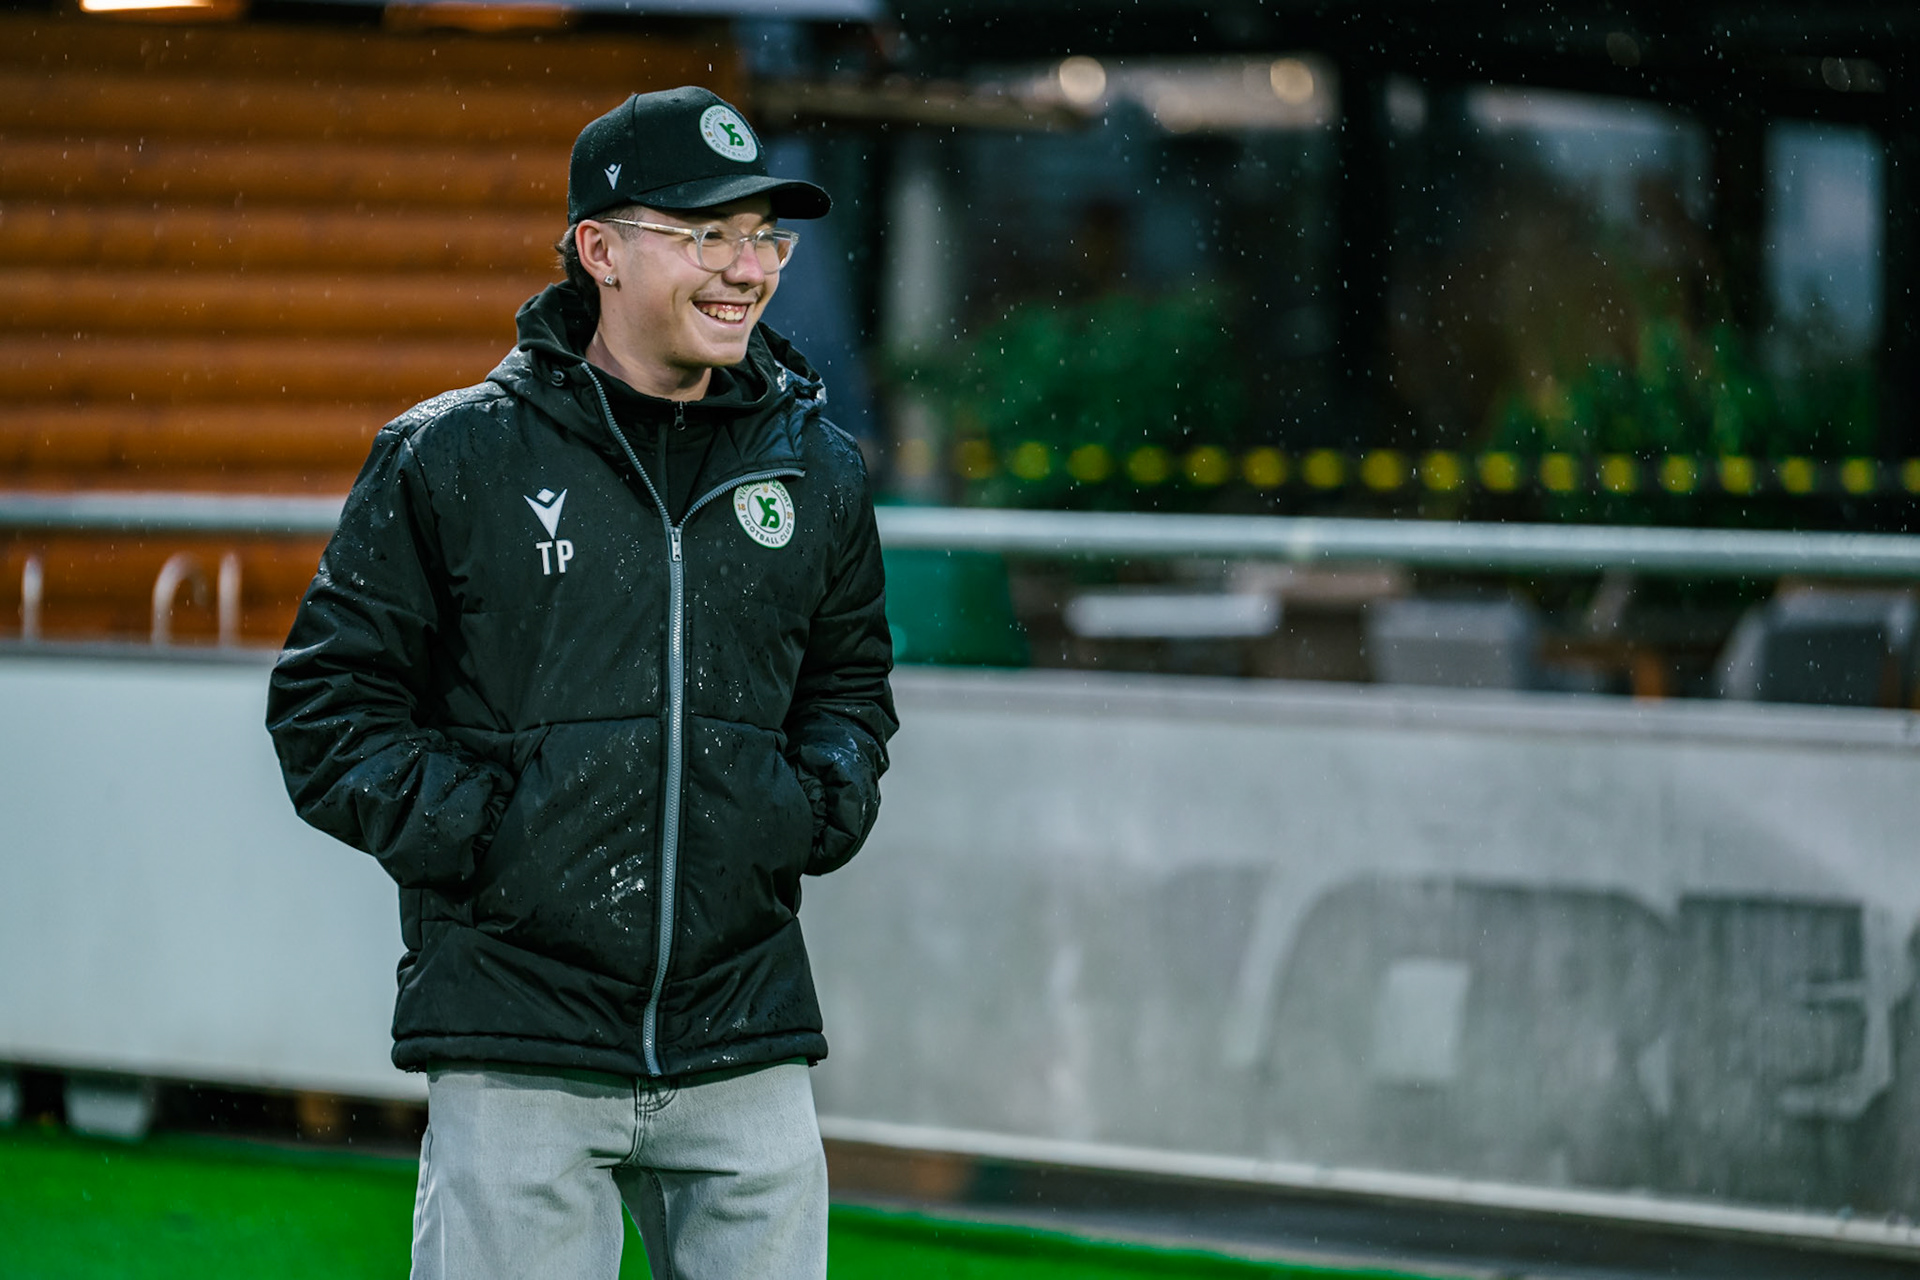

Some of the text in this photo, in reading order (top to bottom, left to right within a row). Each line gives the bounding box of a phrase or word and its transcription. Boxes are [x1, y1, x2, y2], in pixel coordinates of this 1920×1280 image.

[741, 514, 792, 544] FOOTBALL CLUB
[535, 540, 574, 575] TP
